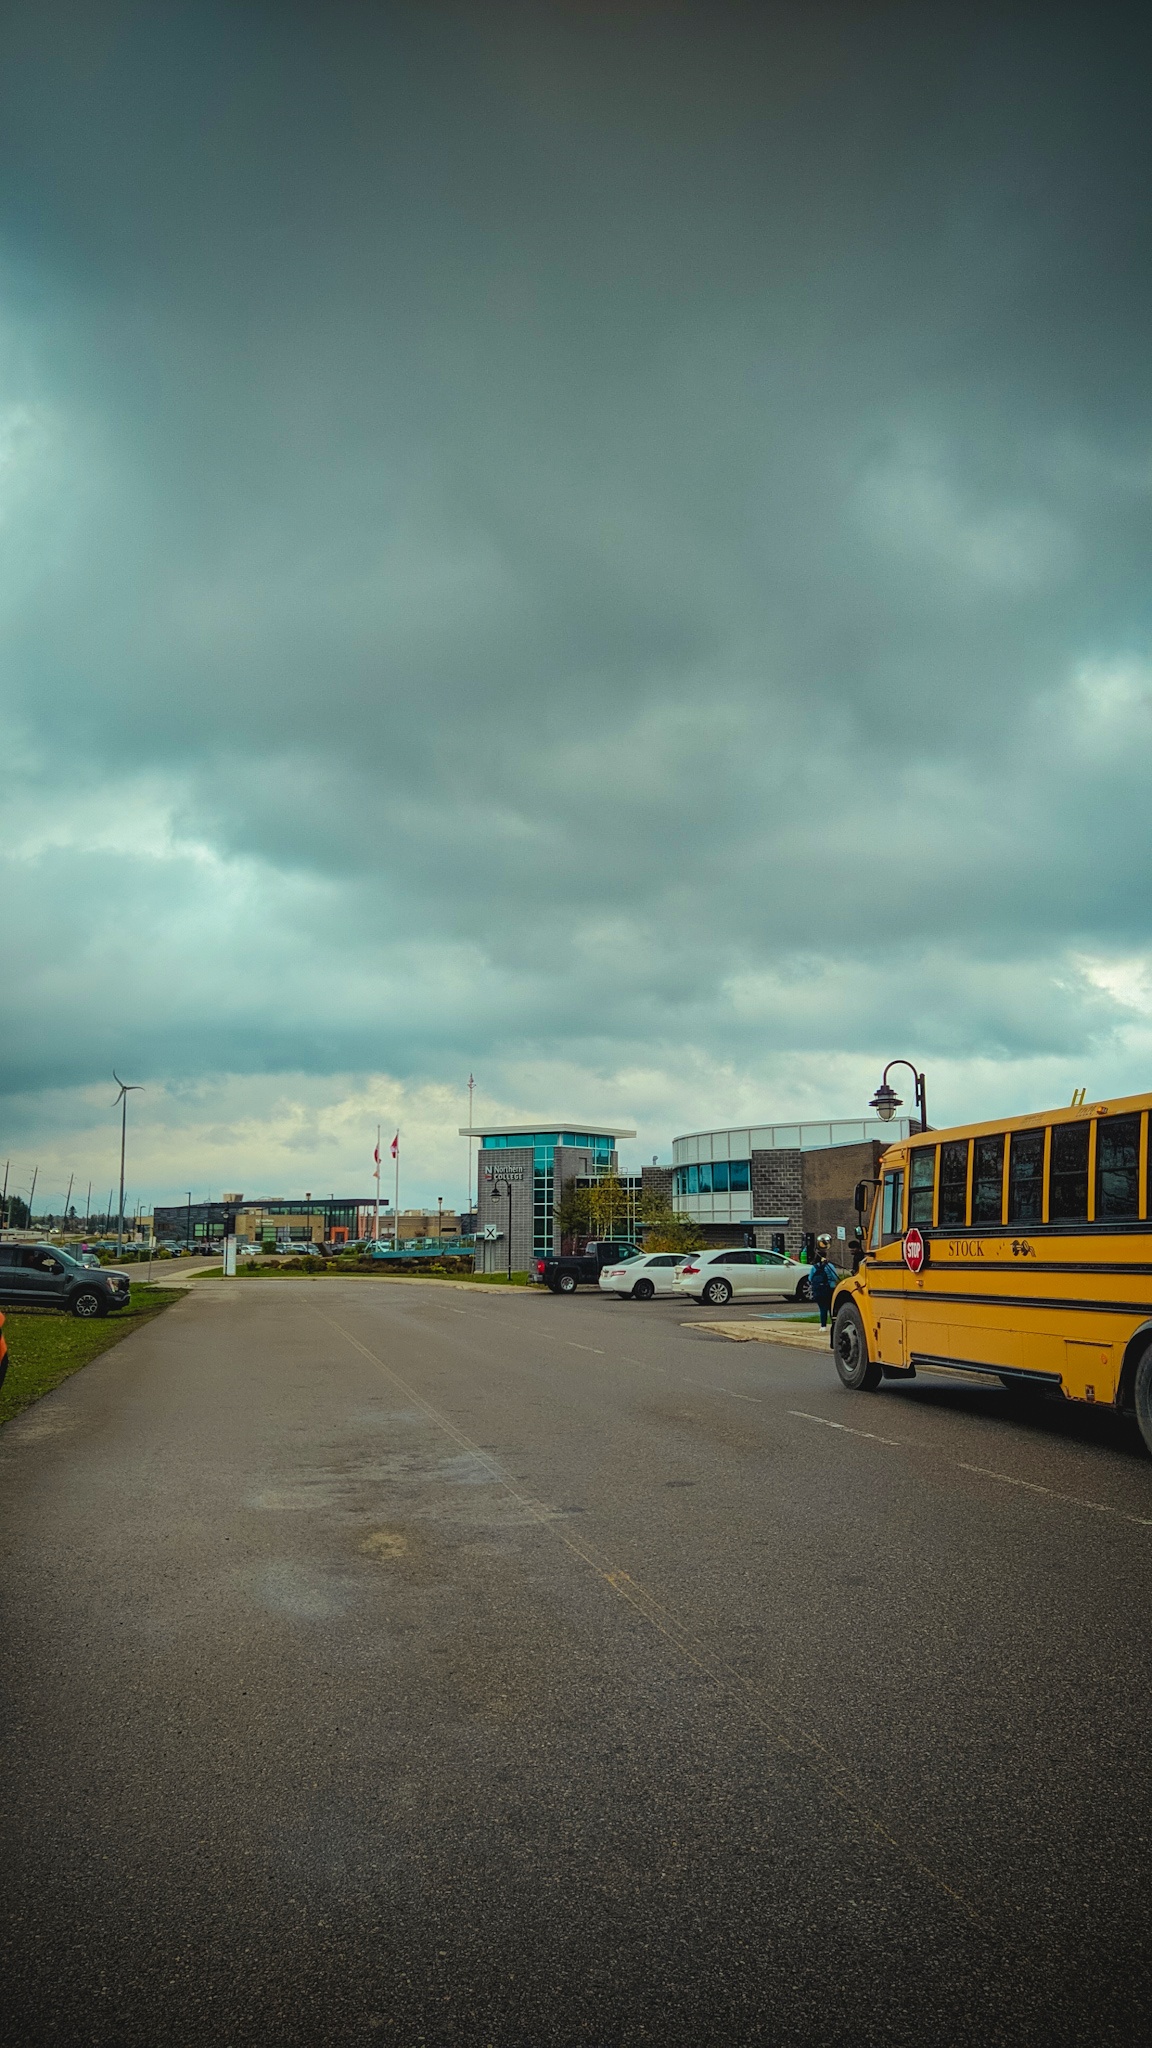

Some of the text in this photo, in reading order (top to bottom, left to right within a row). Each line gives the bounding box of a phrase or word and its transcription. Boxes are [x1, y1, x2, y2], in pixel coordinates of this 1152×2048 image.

[494, 1165, 523, 1173] Northern
[907, 1242, 921, 1259] STOP
[948, 1240, 985, 1257] STOCK
